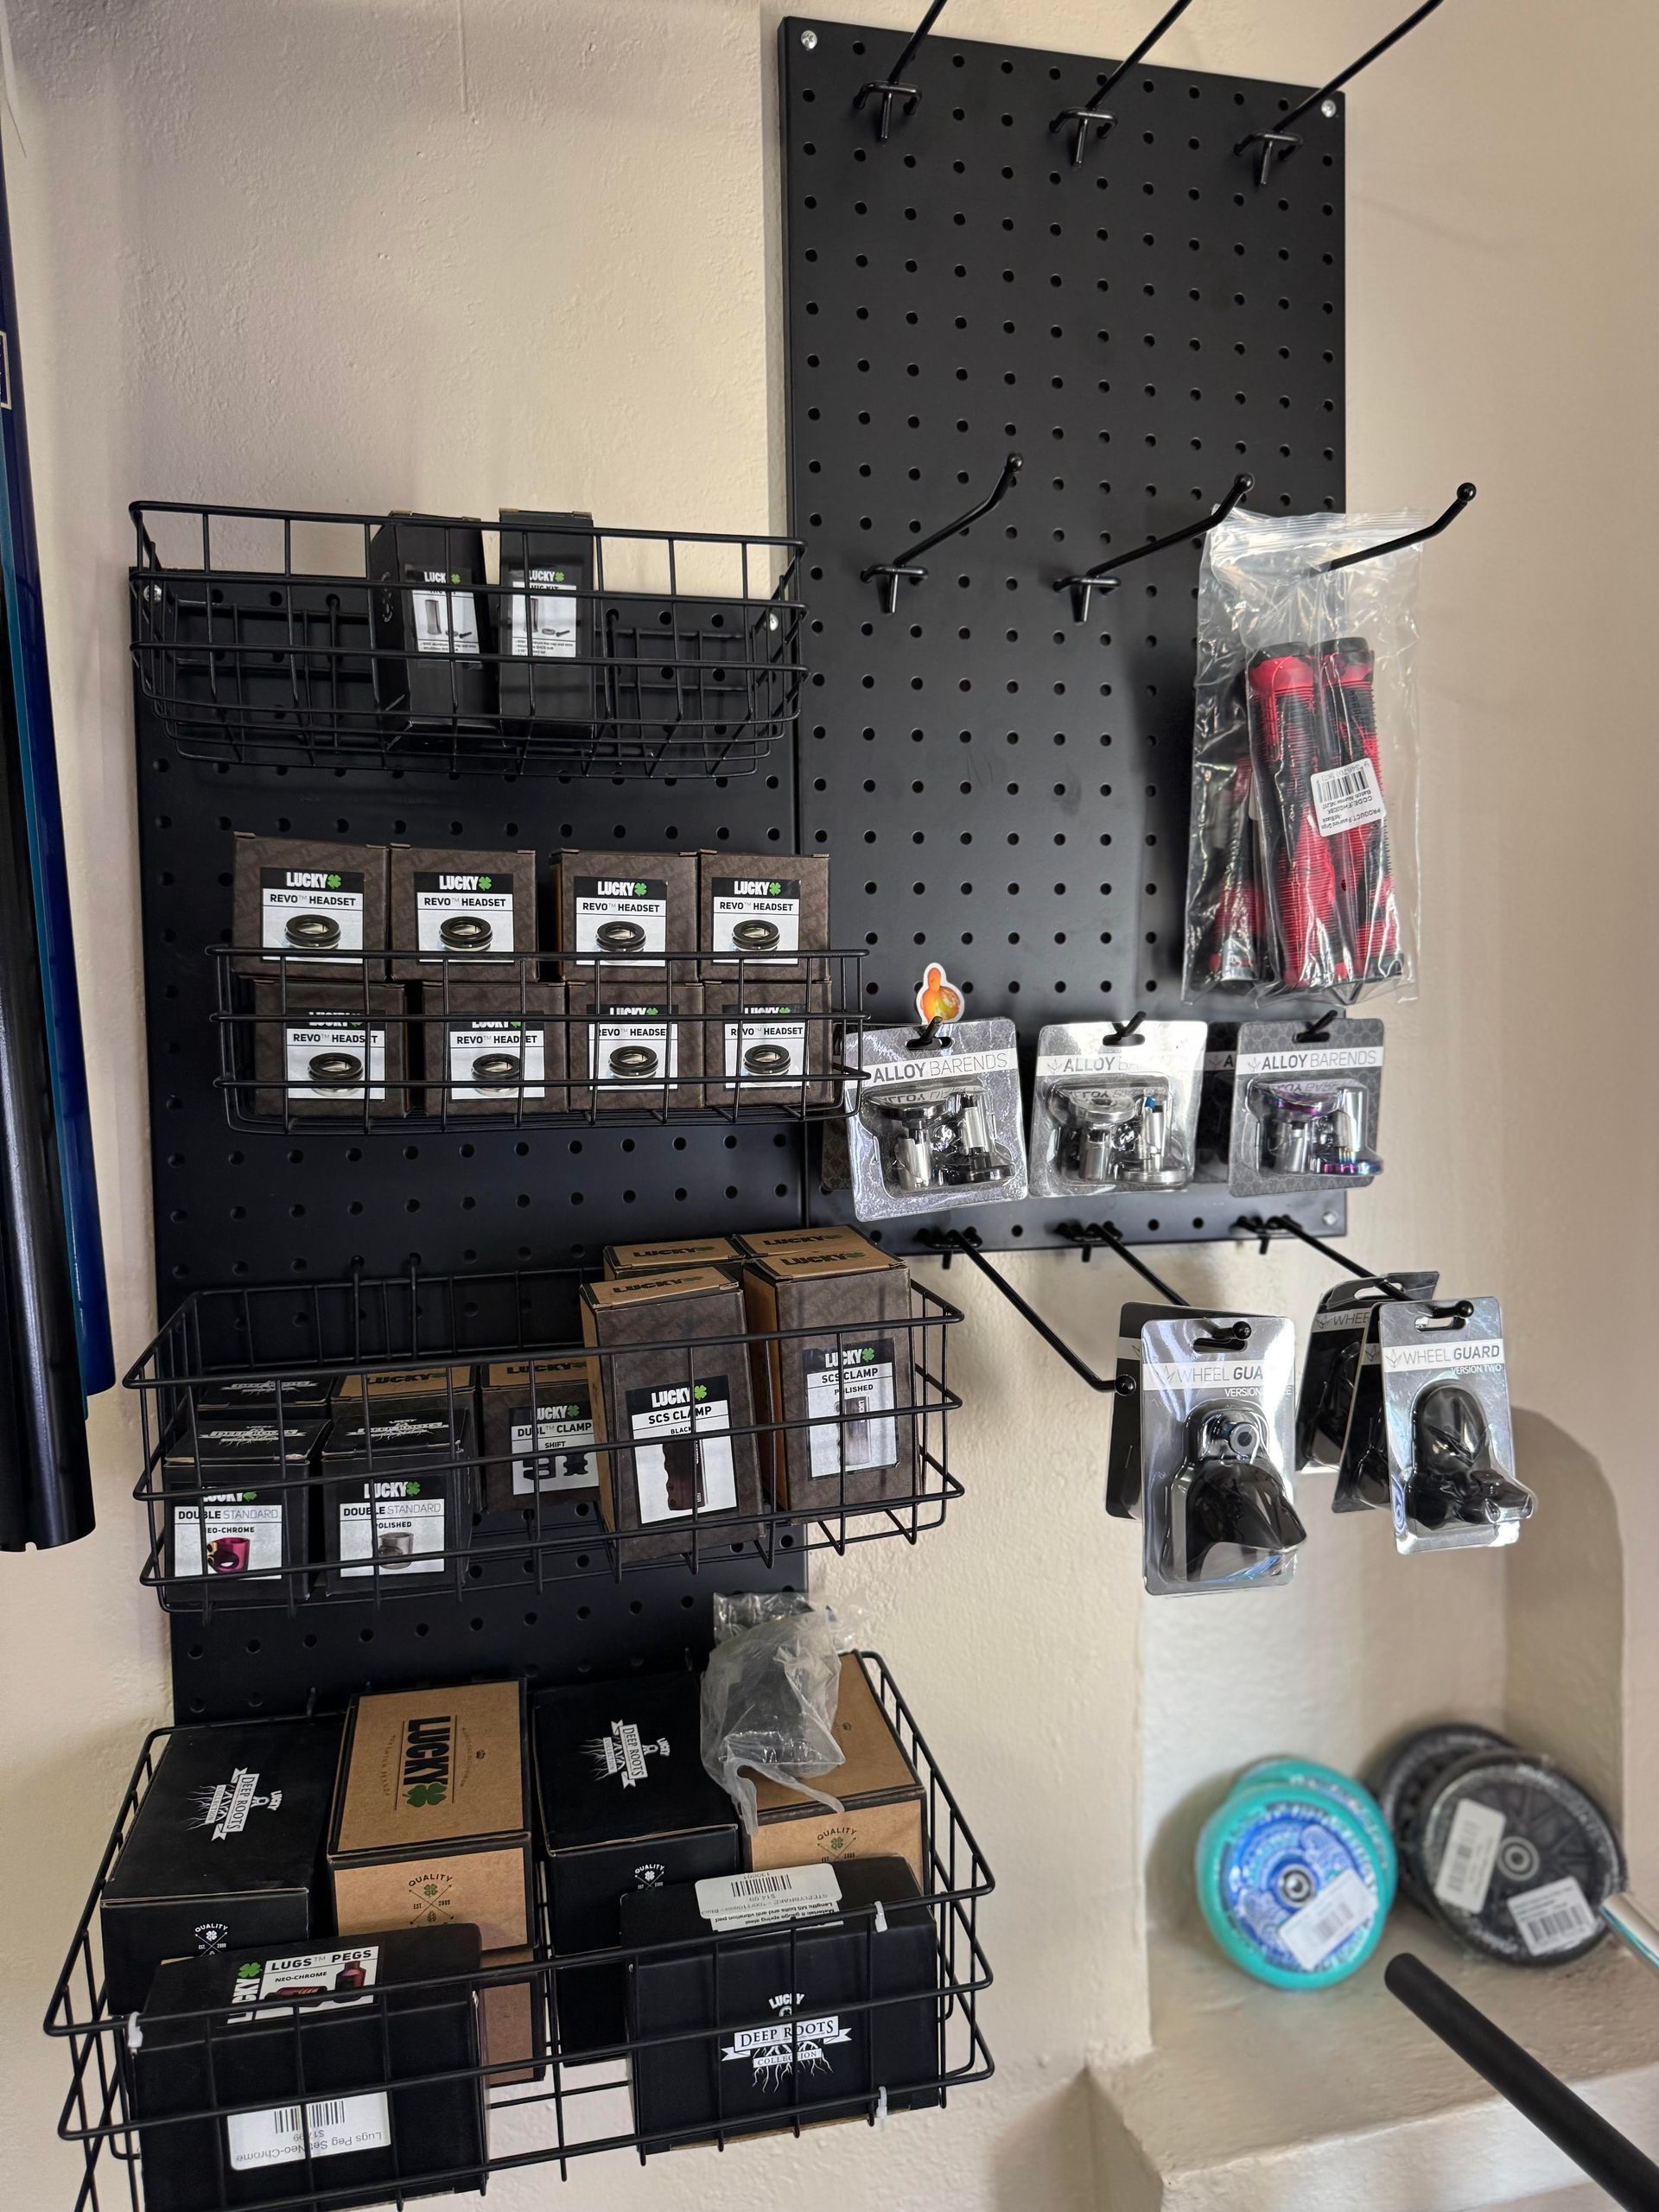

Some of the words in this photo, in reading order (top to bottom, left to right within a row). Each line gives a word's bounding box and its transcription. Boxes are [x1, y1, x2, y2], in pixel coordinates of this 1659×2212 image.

[423, 571, 447, 584] LUCK
[286, 872, 328, 889] LUCKY
[439, 875, 479, 891] LUCKY
[597, 881, 635, 896] LUCKY
[734, 880, 770, 895] LUCKY
[308, 896, 356, 906] HEADSET
[461, 898, 506, 907] HEADSET
[617, 903, 660, 912] HEADSET
[753, 902, 793, 912] HEADSET
[332, 1034, 378, 1043] HEADST
[493, 1035, 537, 1044] HEADET
[1063, 1057, 1116, 1072] ALLOY
[1262, 1053, 1308, 1071] ALLOY
[1310, 1050, 1376, 1067] BARENDS
[873, 1062, 926, 1084] ALLOY
[930, 1052, 1007, 1077] BARENDS
[763, 1236, 825, 1246] LUCKY
[632, 1247, 697, 1257] LUCKY
[781, 1253, 848, 1266] LUCKY
[613, 1279, 683, 1294] LUCKY
[1333, 1312, 1370, 1327] WHEE
[1403, 1349, 1451, 1364] WHEEL
[1453, 1345, 1500, 1360] GUARD
[822, 1374, 840, 1383] SCS
[843, 1368, 878, 1381] CLAMP
[1177, 1366, 1230, 1382] WHEEL
[1233, 1365, 1264, 1381] GUA
[1451, 1365, 1483, 1375] VERSION
[1484, 1364, 1502, 1373] TWO
[834, 1384, 874, 1395] PLISHED
[537, 1405, 568, 1421] UCKY
[648, 1413, 670, 1424] SCS
[556, 1422, 592, 1433] CLAMP
[544, 1440, 566, 1449] SHIFT
[223, 1509, 278, 1519] STANDARD
[387, 1503, 442, 1515] STANDARD
[623, 1727, 638, 1746] DEEP
[403, 1715, 451, 1786] LUCKY
[629, 1748, 645, 1777] ROOTS
[239, 1777, 255, 1797] DEEP
[226, 1800, 248, 1829] ROOTS
[817, 1827, 857, 1840] QUALITY
[634, 1863, 665, 1874] QUALITY
[408, 1873, 453, 1886] QUALITY
[194, 1923, 228, 1933] QUALITY
[332, 1949, 372, 1963] PEGS
[275, 1971, 327, 1983] NEO-CHROME
[227, 1978, 261, 2024] LCKY
[741, 2028, 778, 2047] DEEP
[758, 2051, 817, 2066] COLLECION
[331, 2136, 353, 2146] Peg
[355, 2131, 382, 2142] Lugs
